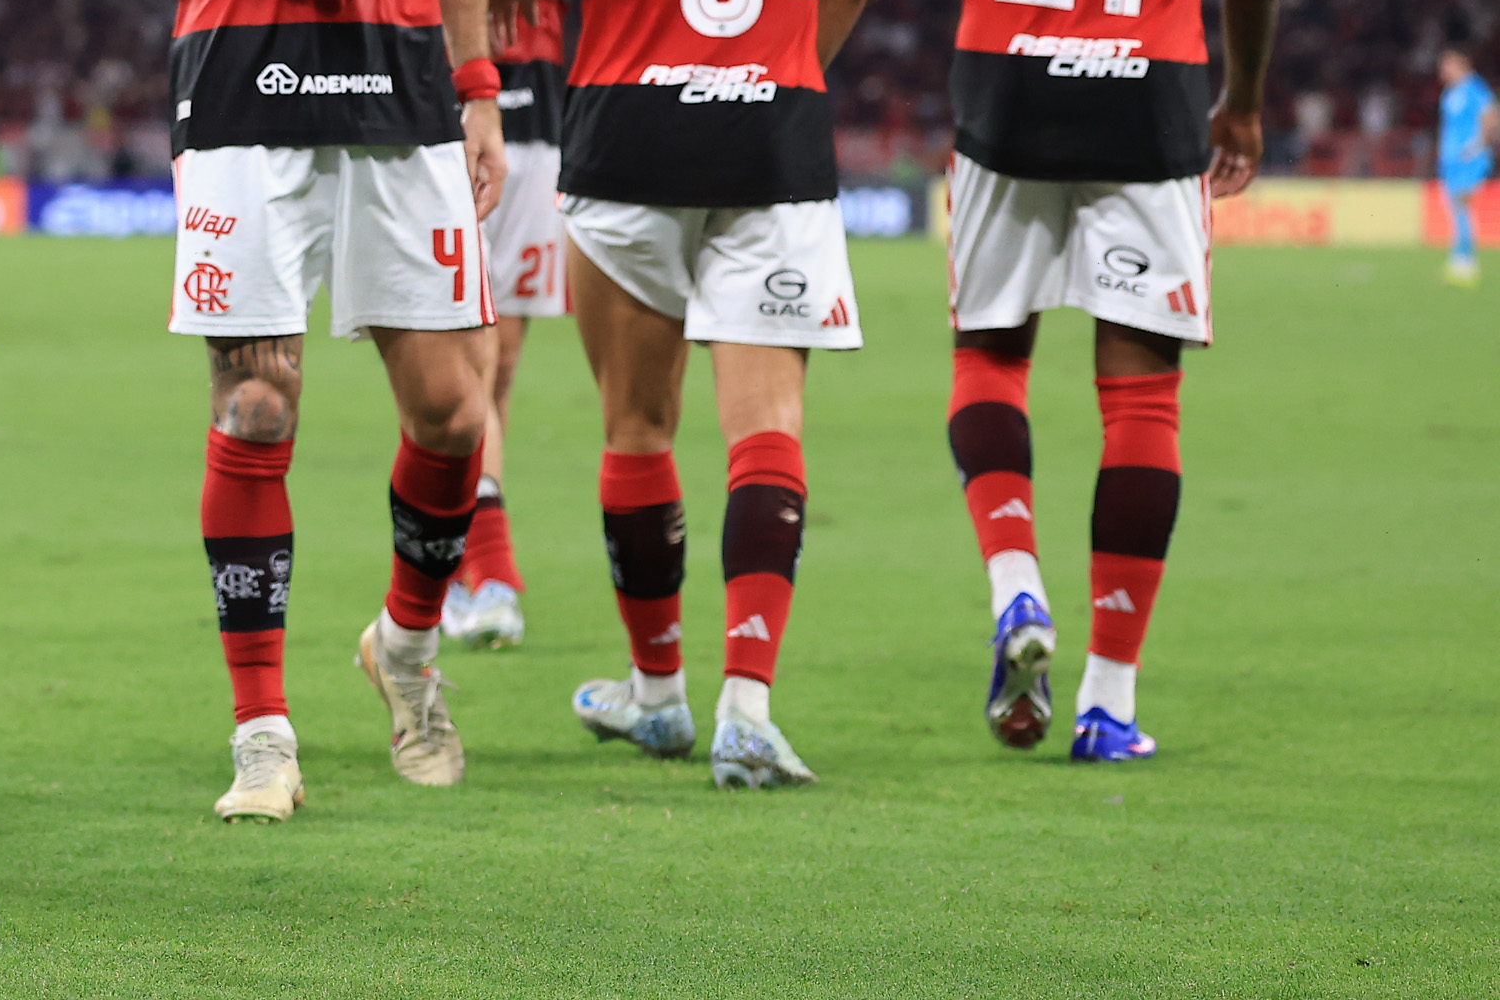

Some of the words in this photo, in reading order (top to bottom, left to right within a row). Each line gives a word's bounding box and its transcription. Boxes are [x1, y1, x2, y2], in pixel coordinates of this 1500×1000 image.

[1007, 33, 1143, 57] ASSIST
[639, 63, 769, 86] ASSIST
[1046, 56, 1151, 79] CARD
[300, 74, 393, 95] ADEMICON
[679, 81, 778, 104] CARD
[185, 205, 238, 240] Wap
[432, 228, 465, 302] 4
[514, 242, 556, 298] 21
[1097, 273, 1148, 297] GAC
[759, 302, 810, 318] GAC
